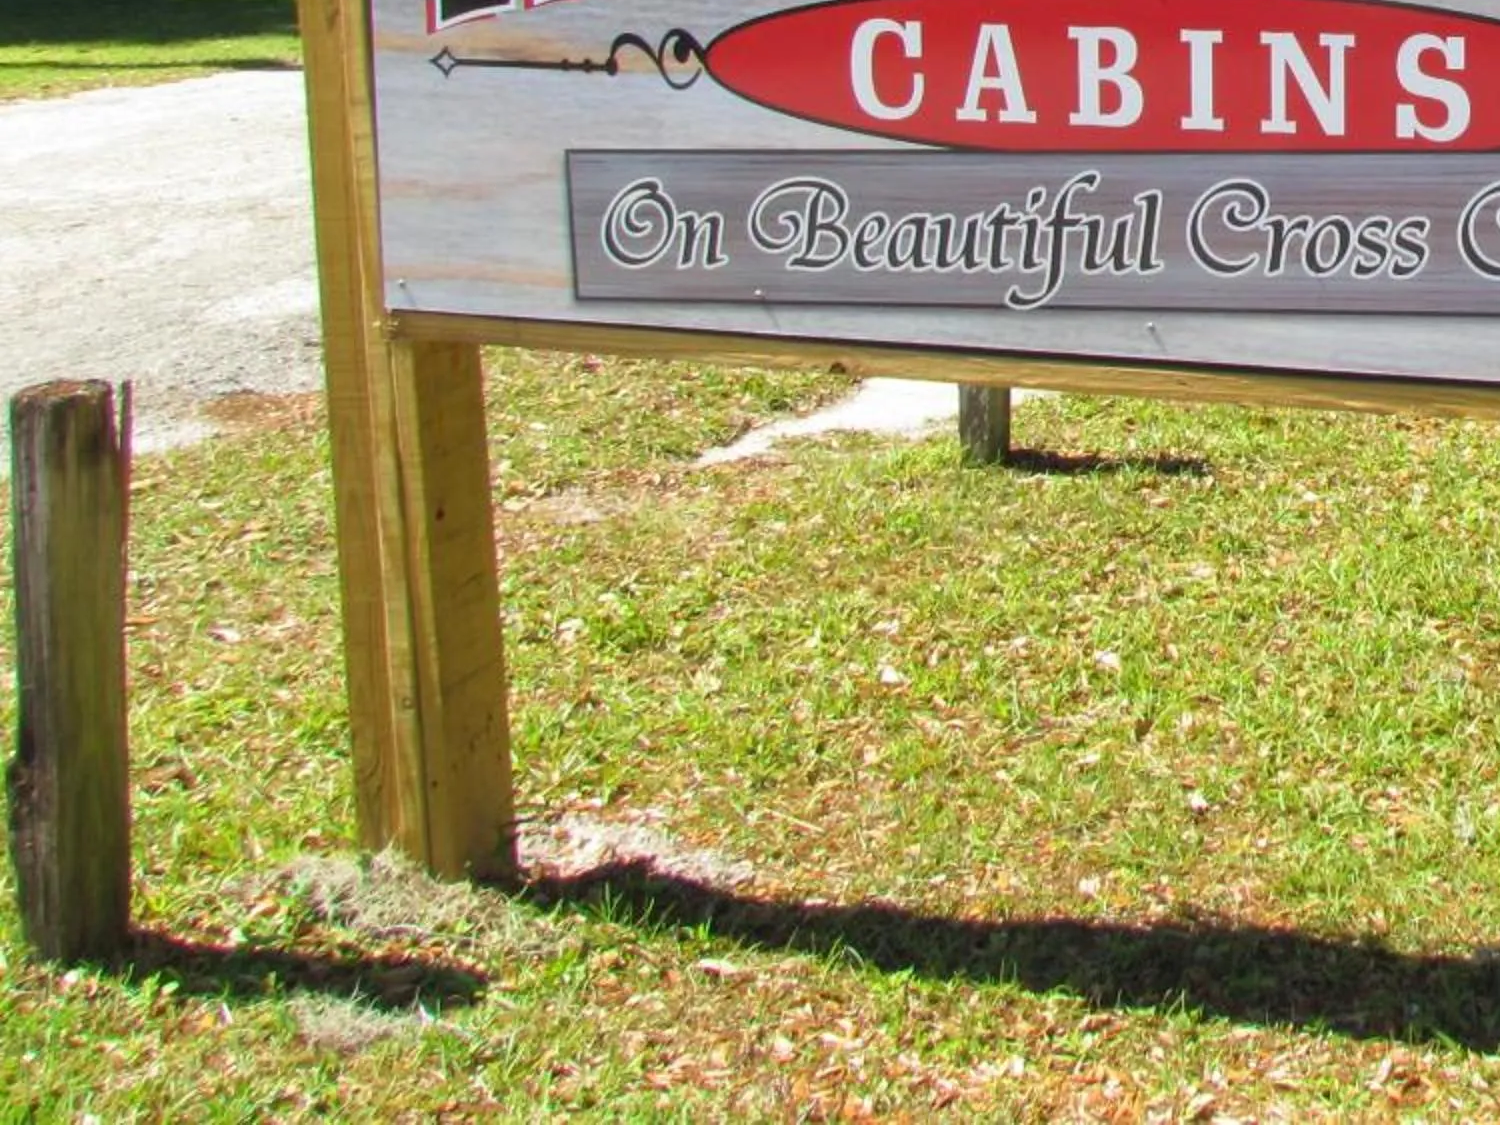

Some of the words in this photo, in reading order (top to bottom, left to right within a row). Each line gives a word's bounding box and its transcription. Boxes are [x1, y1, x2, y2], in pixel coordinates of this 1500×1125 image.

[849, 18, 1471, 142] CABINS
[602, 178, 728, 271] On
[748, 169, 1163, 311] Beautiful
[1187, 178, 1430, 279] Cross
